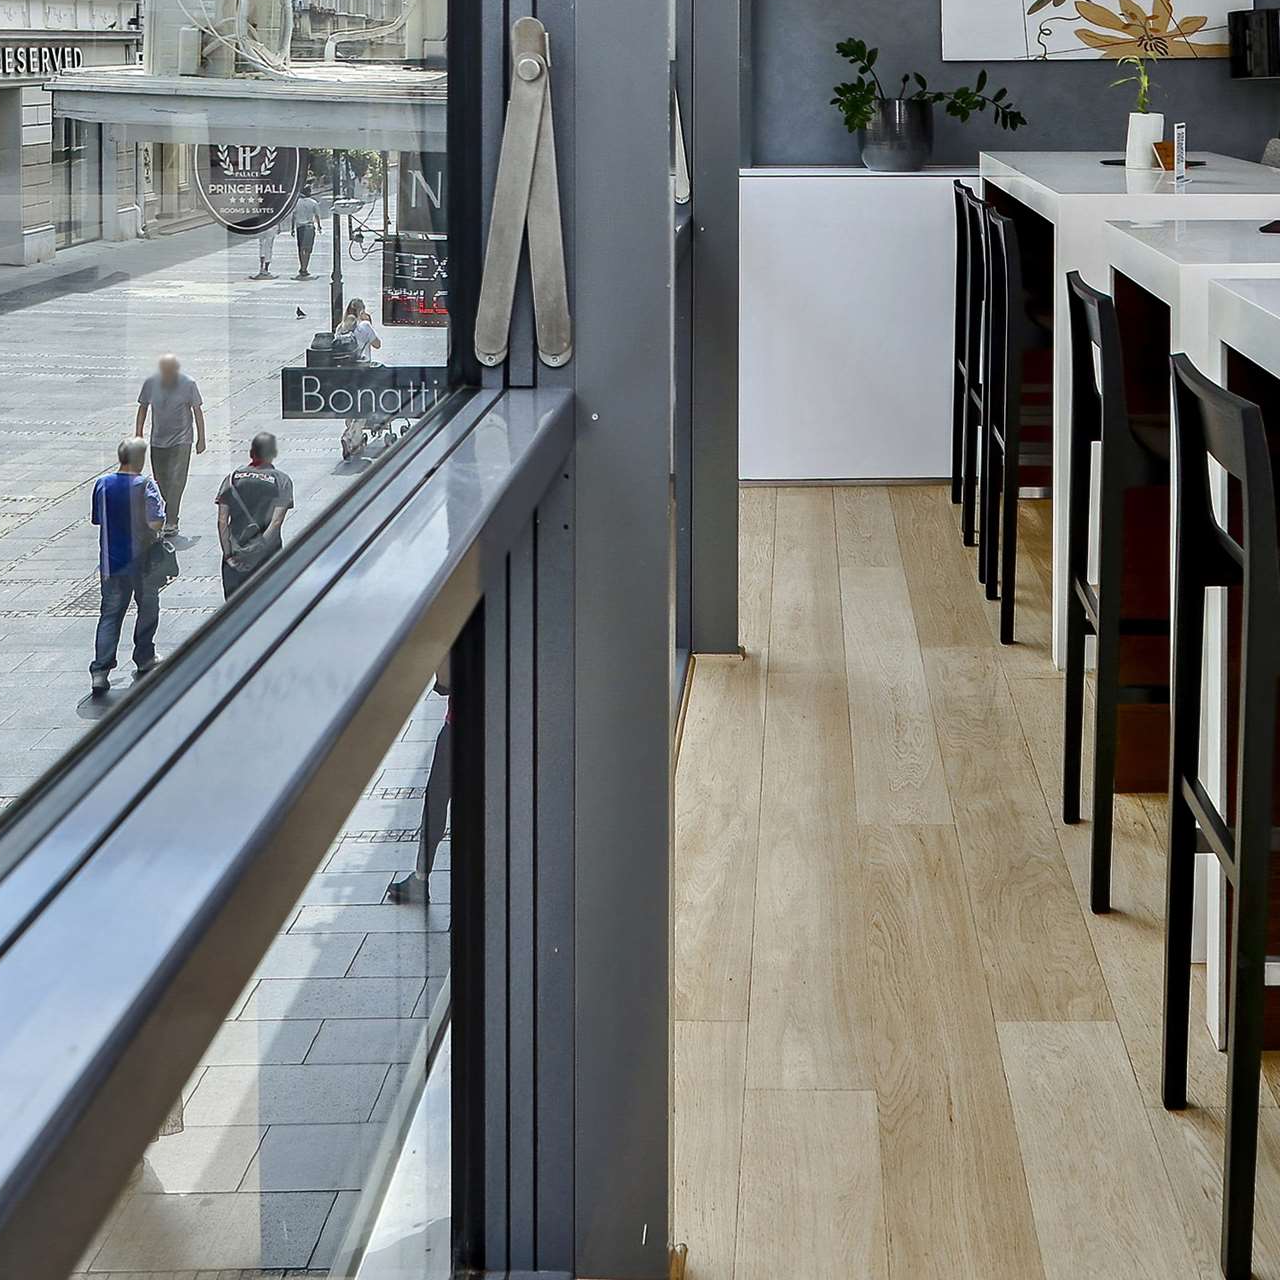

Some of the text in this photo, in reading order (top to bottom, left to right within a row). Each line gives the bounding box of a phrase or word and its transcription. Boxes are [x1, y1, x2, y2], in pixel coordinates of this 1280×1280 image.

[208, 183, 287, 194] PRINCE HALL
[301, 375, 439, 414] Bonatti
